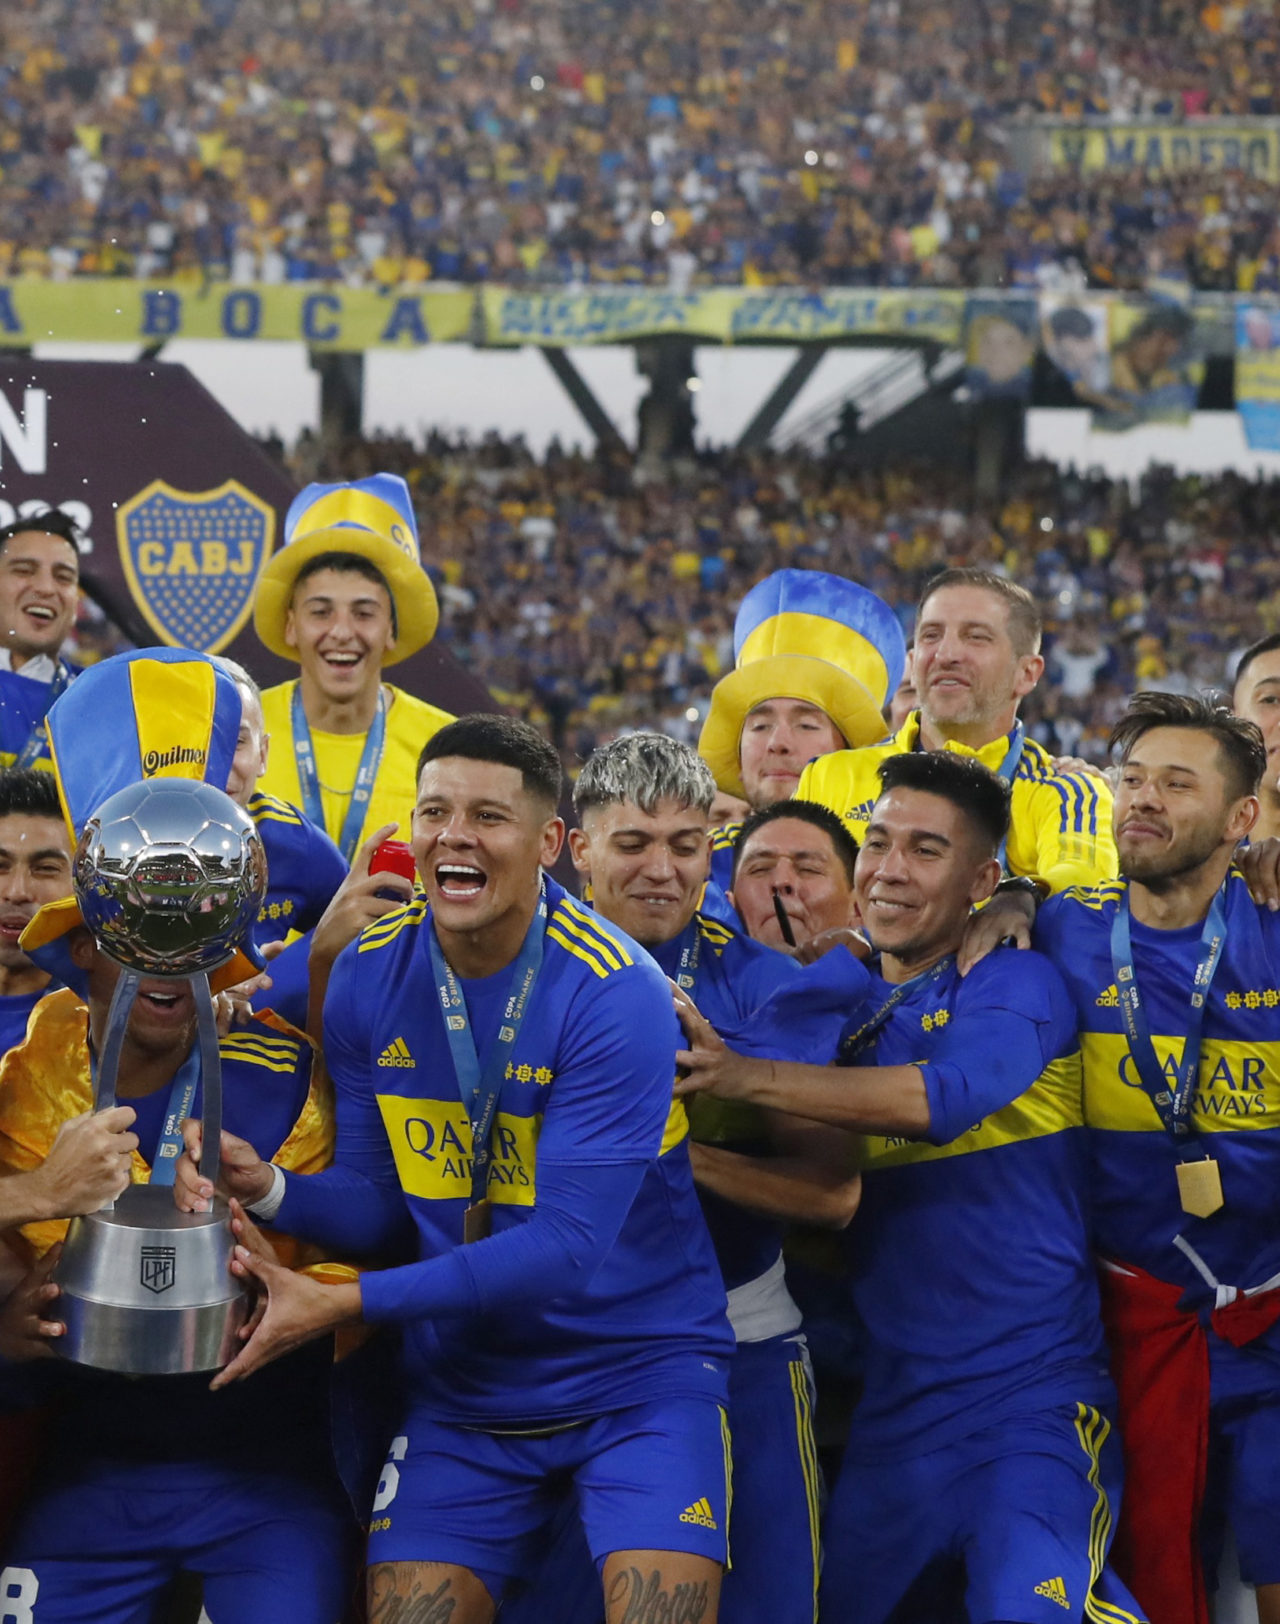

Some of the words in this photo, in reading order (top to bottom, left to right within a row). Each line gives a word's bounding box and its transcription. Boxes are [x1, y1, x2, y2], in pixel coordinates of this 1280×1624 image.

[141, 291, 430, 343] BOCA
[138, 541, 256, 575] CABJ
[143, 745, 206, 777] Quilmes
[845, 810, 870, 822] adid
[445, 962, 458, 995] BINAN
[517, 967, 535, 1009] BINANCE
[440, 985, 451, 1008] COPA
[504, 996, 517, 1018] COPA
[1129, 986, 1140, 1009] COPA
[377, 1055, 416, 1069] adidas
[1173, 1092, 1182, 1115] COPA
[1189, 1093, 1267, 1116] WAYS
[165, 1113, 177, 1136] COPA
[404, 1117, 522, 1163] QAR
[441, 1157, 530, 1186] AIAYS
[678, 1512, 718, 1531] adidas
[1034, 1585, 1070, 1610] adidas
